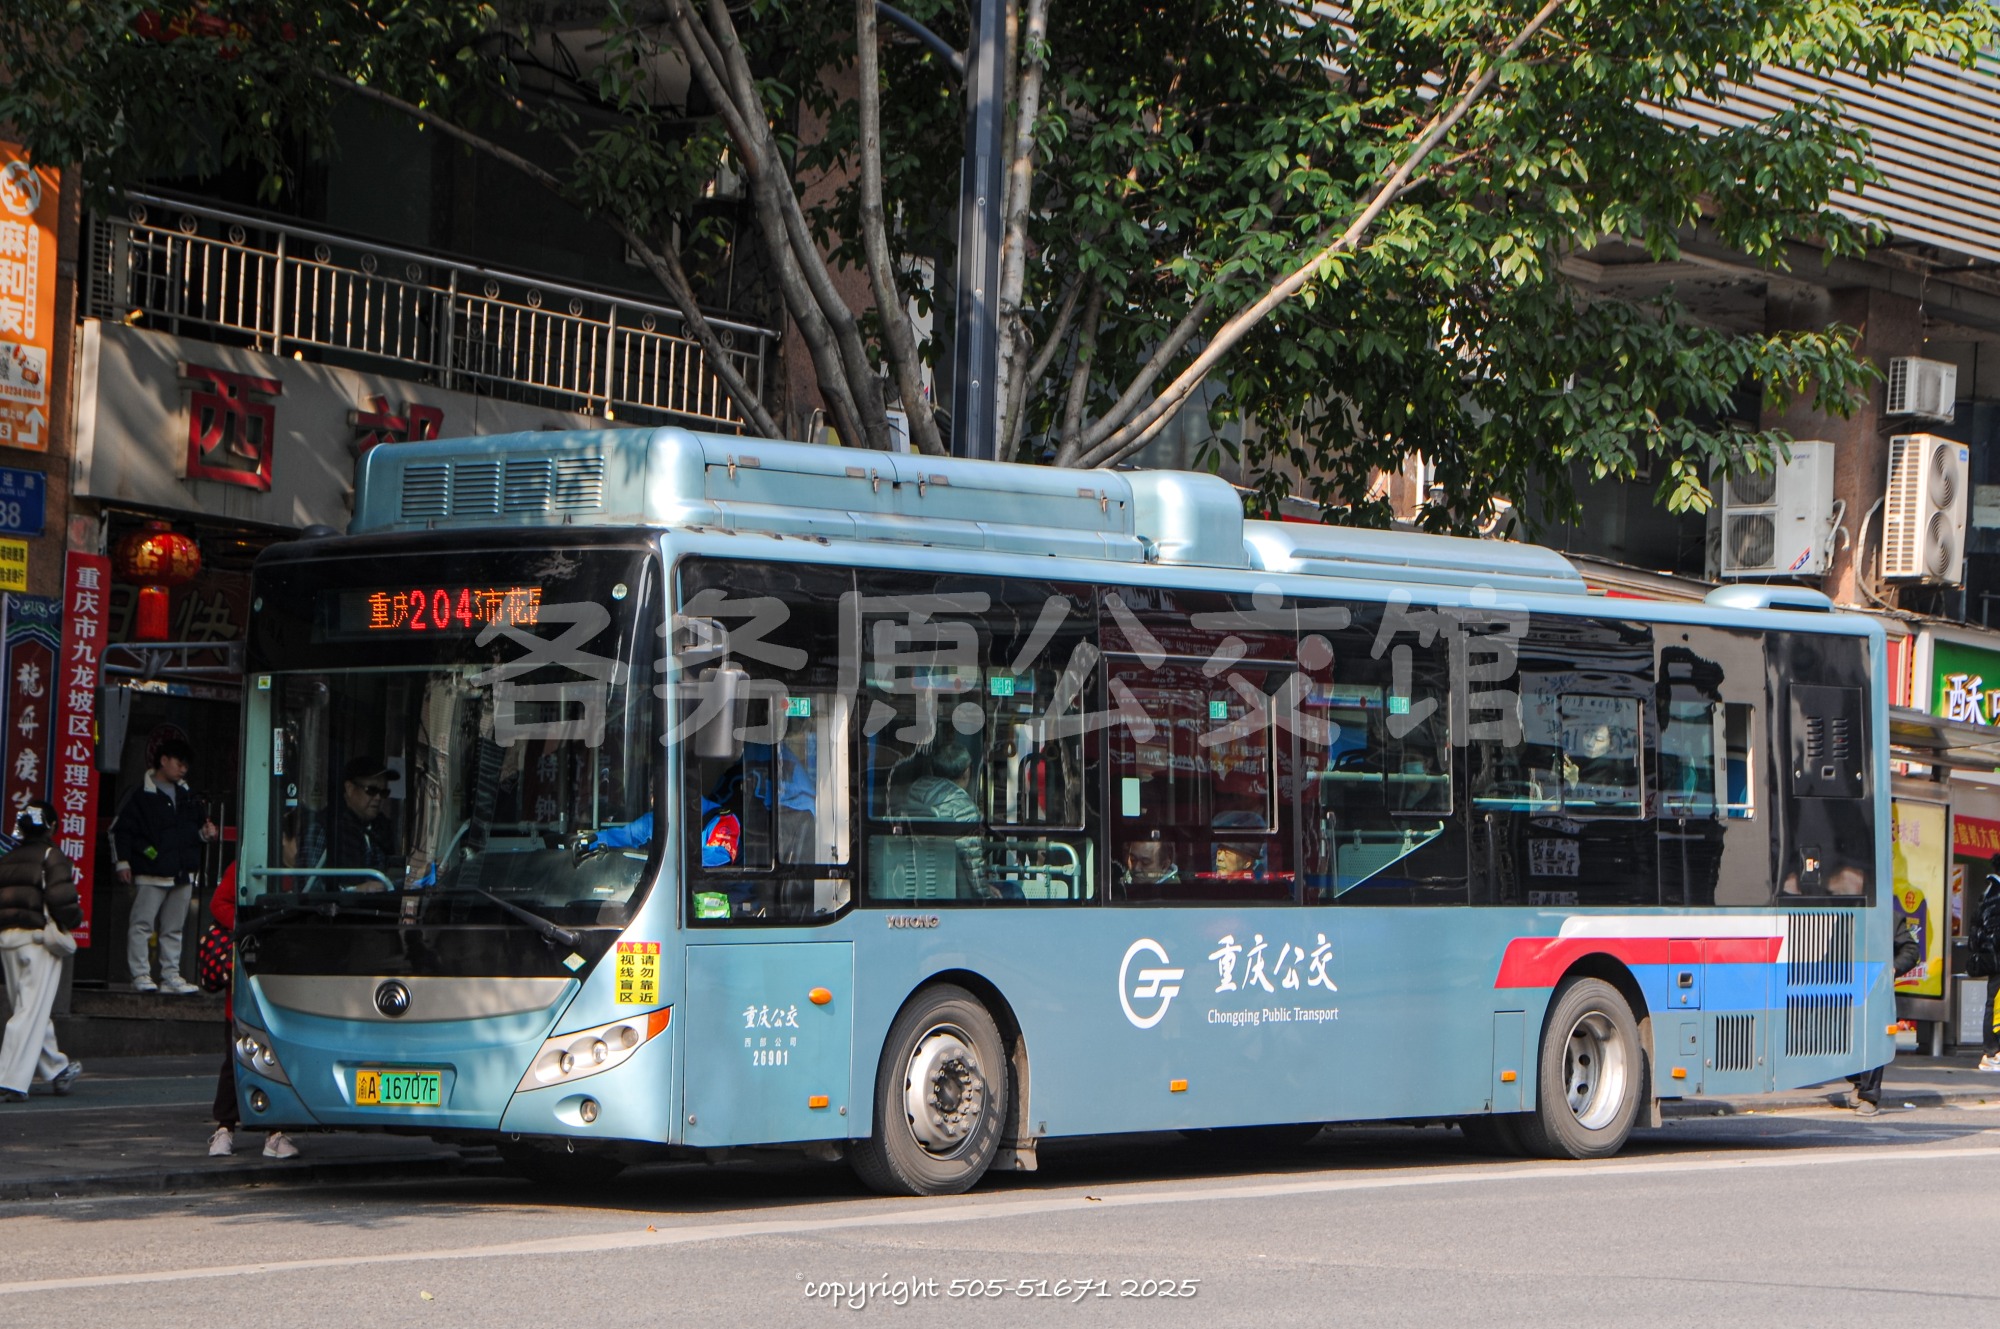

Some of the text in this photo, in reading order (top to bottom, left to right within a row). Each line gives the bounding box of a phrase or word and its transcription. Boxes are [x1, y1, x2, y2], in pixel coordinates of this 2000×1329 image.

[60, 567, 101, 906] 重庆市九龙坡区心理咨询师
[633, 943, 658, 954] 危险
[1208, 933, 1338, 993] 重庆公交
[620, 954, 635, 1003] 视线盲区
[639, 955, 655, 1003] 请勿靠近
[742, 1004, 799, 1029] 重庆公交
[1207, 1007, 1339, 1027] Chongqing Public Transport
[753, 1050, 788, 1066] 26901
